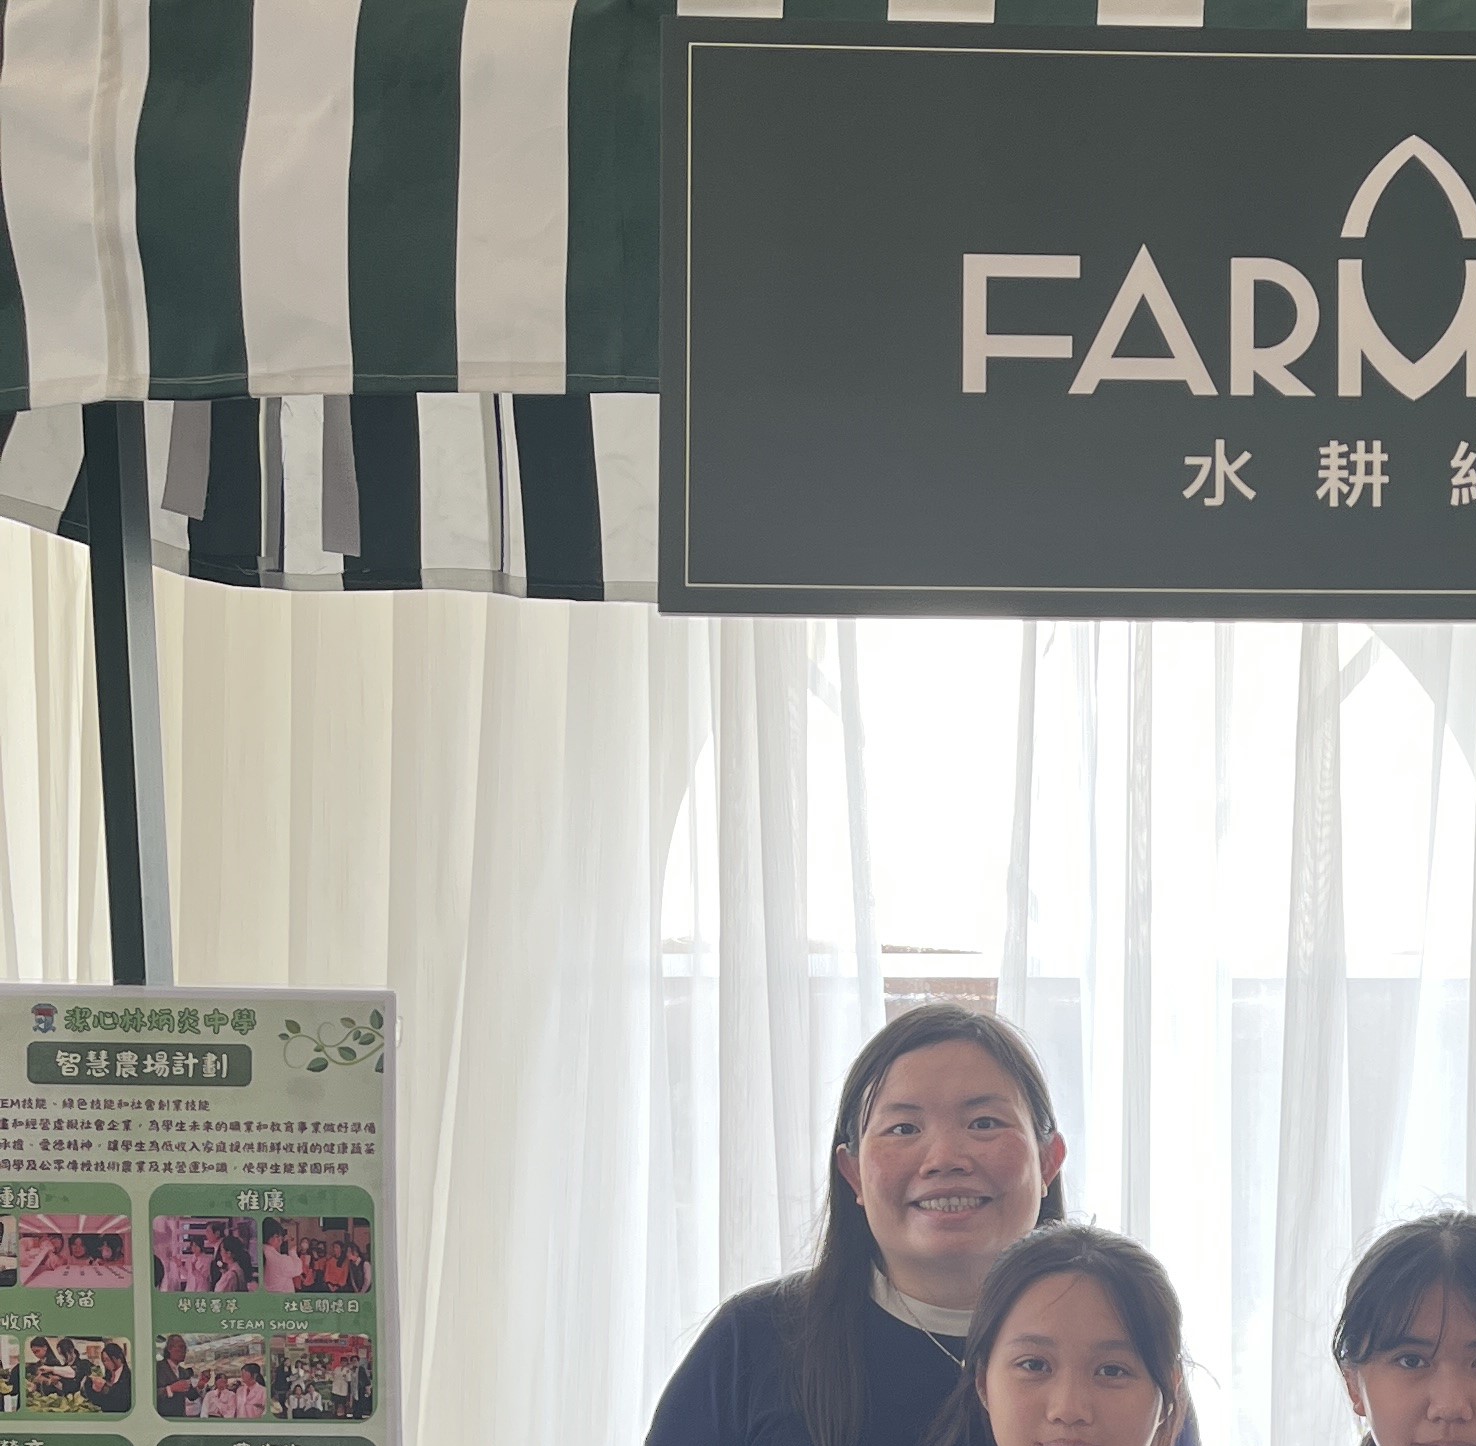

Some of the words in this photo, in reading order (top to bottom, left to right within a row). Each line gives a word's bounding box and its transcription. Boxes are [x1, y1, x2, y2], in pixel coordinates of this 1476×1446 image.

[64, 1006, 257, 1036] 潔心林炳炎中學
[55, 1050, 229, 1079] 智慧農場計劃
[237, 1189, 285, 1213] 推廣
[56, 1289, 95, 1308] 移苗
[221, 1318, 265, 1331] STEAM
[270, 1319, 308, 1331] SHOW
